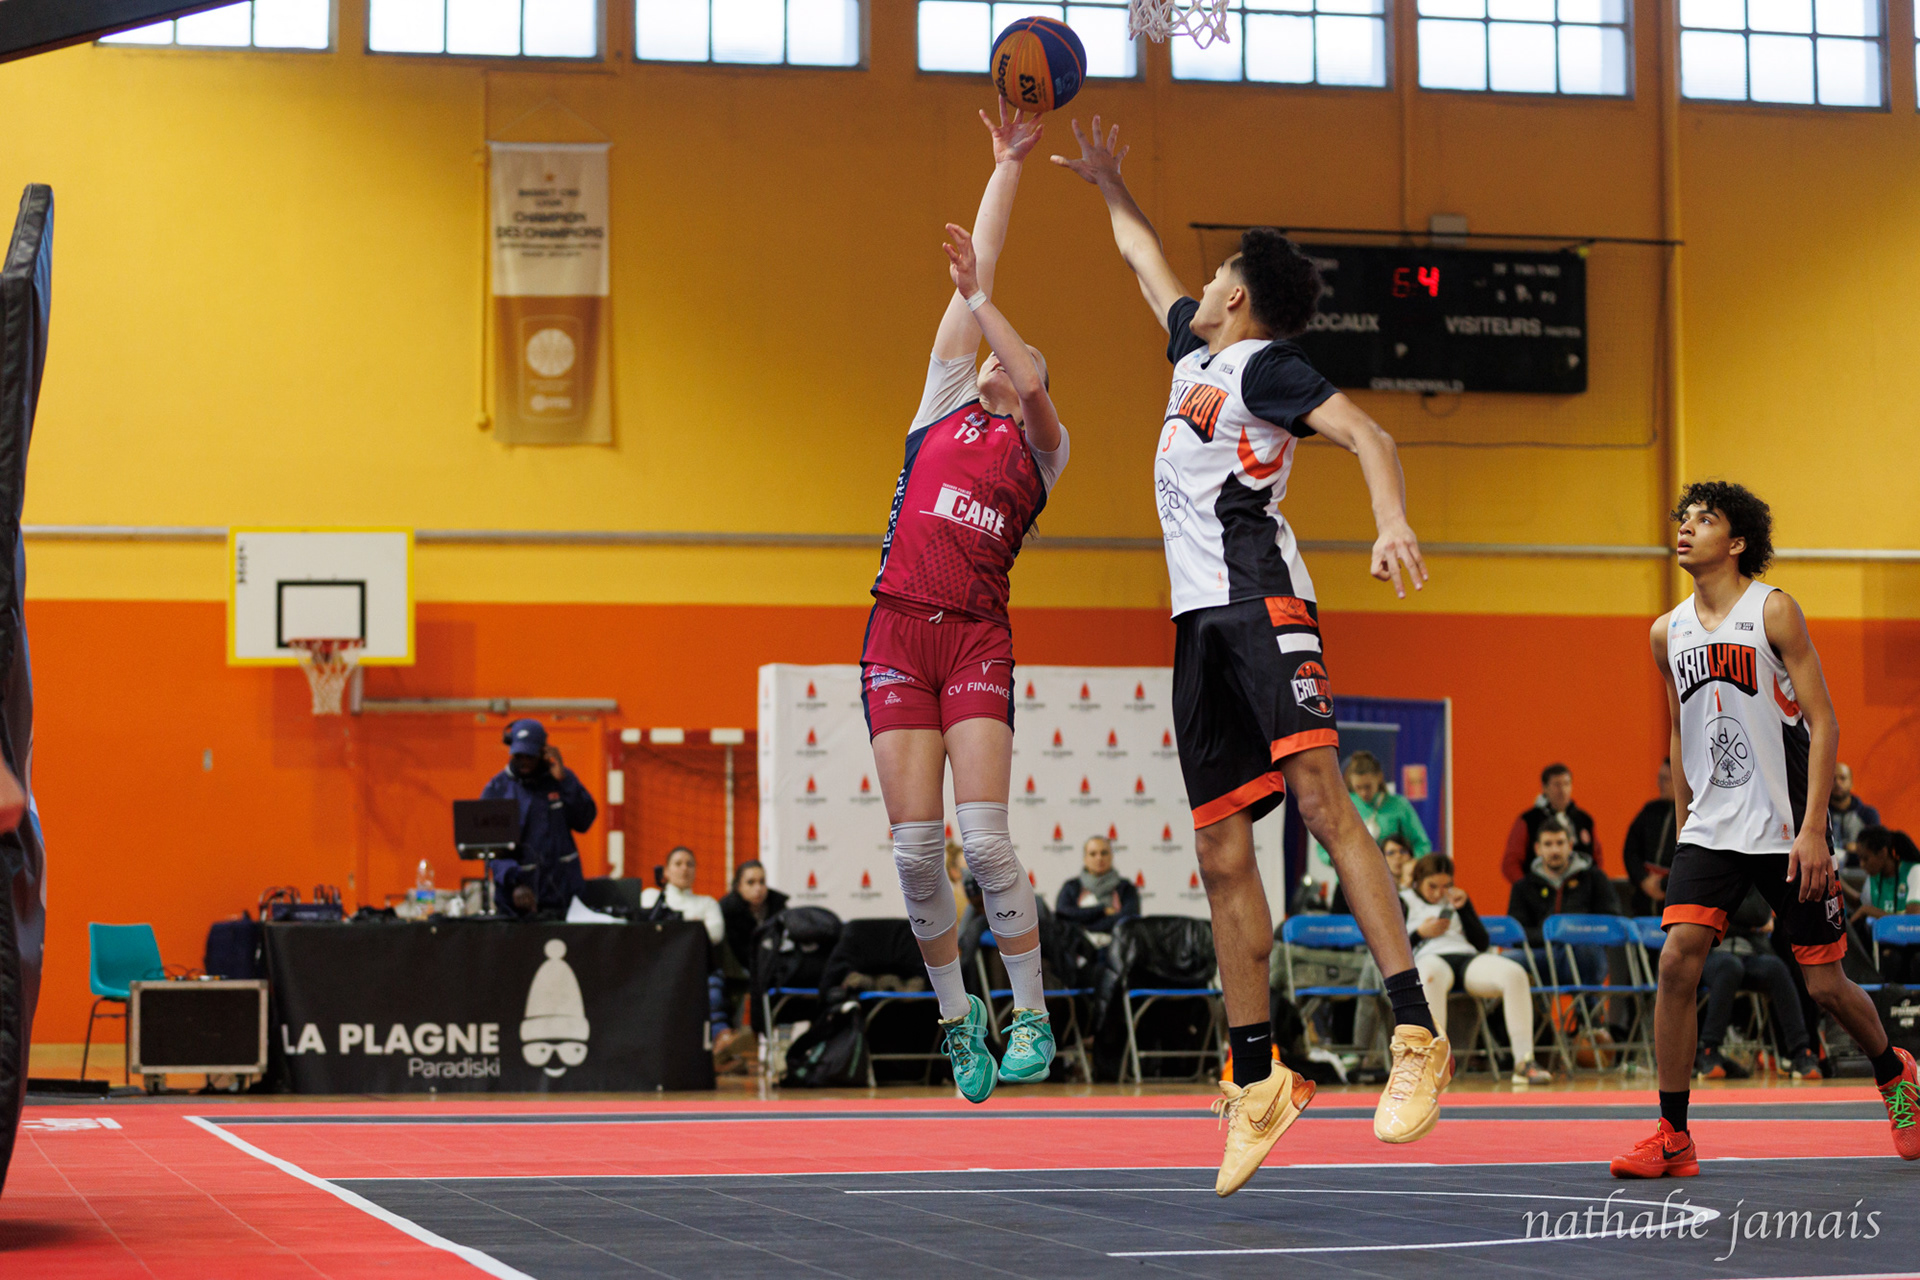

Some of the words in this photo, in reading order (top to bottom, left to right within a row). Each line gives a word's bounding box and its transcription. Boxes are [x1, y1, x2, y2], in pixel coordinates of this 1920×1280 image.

[1446, 316, 1542, 337] VISITEURS
[953, 423, 980, 444] 19
[1162, 425, 1177, 452] 3
[948, 684, 963, 696] CV
[967, 682, 1010, 700] FINANCE
[1714, 687, 1723, 713] 1
[282, 1023, 326, 1055] LA
[339, 1023, 500, 1055] PLAGNE
[408, 1057, 500, 1078] Paradiski
